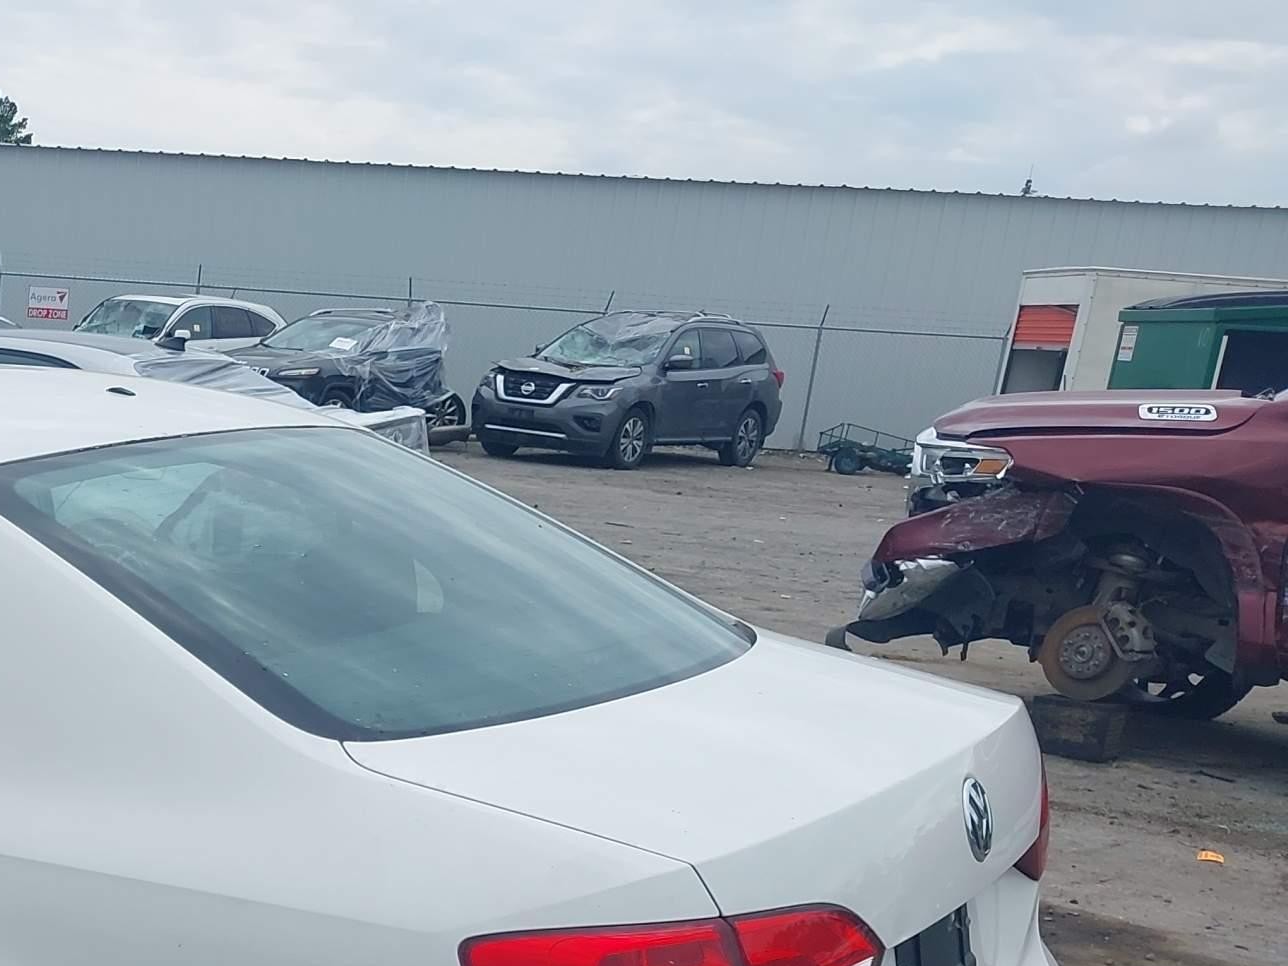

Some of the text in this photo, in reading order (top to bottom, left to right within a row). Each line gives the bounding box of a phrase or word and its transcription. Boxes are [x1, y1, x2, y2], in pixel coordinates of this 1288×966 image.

[28, 308, 67, 319] DROP ZONE
[1151, 407, 1206, 415] 1500
